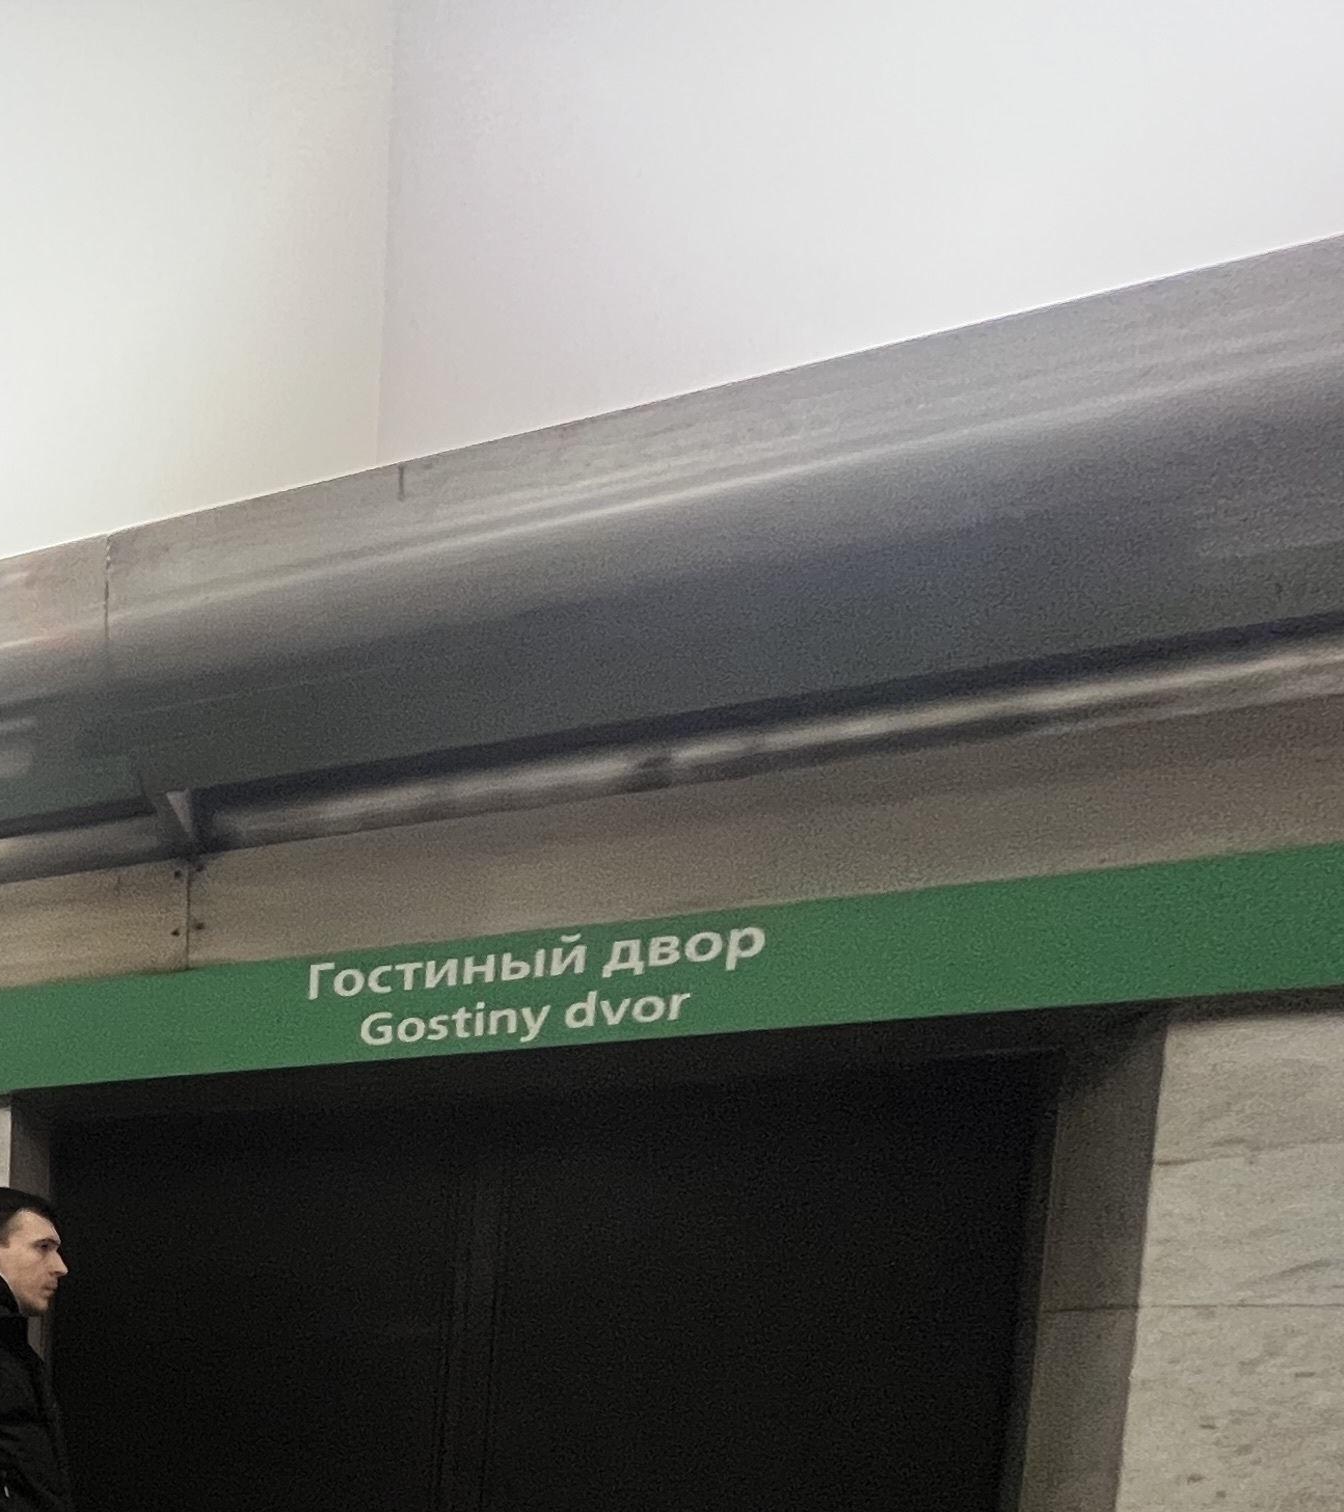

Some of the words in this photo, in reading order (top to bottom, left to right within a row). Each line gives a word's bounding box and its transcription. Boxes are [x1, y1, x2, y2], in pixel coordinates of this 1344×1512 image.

[307, 932, 588, 1001] Гостиный
[600, 925, 767, 979] двор
[359, 1001, 552, 1046] Gostiny
[564, 989, 692, 1030] dvor
